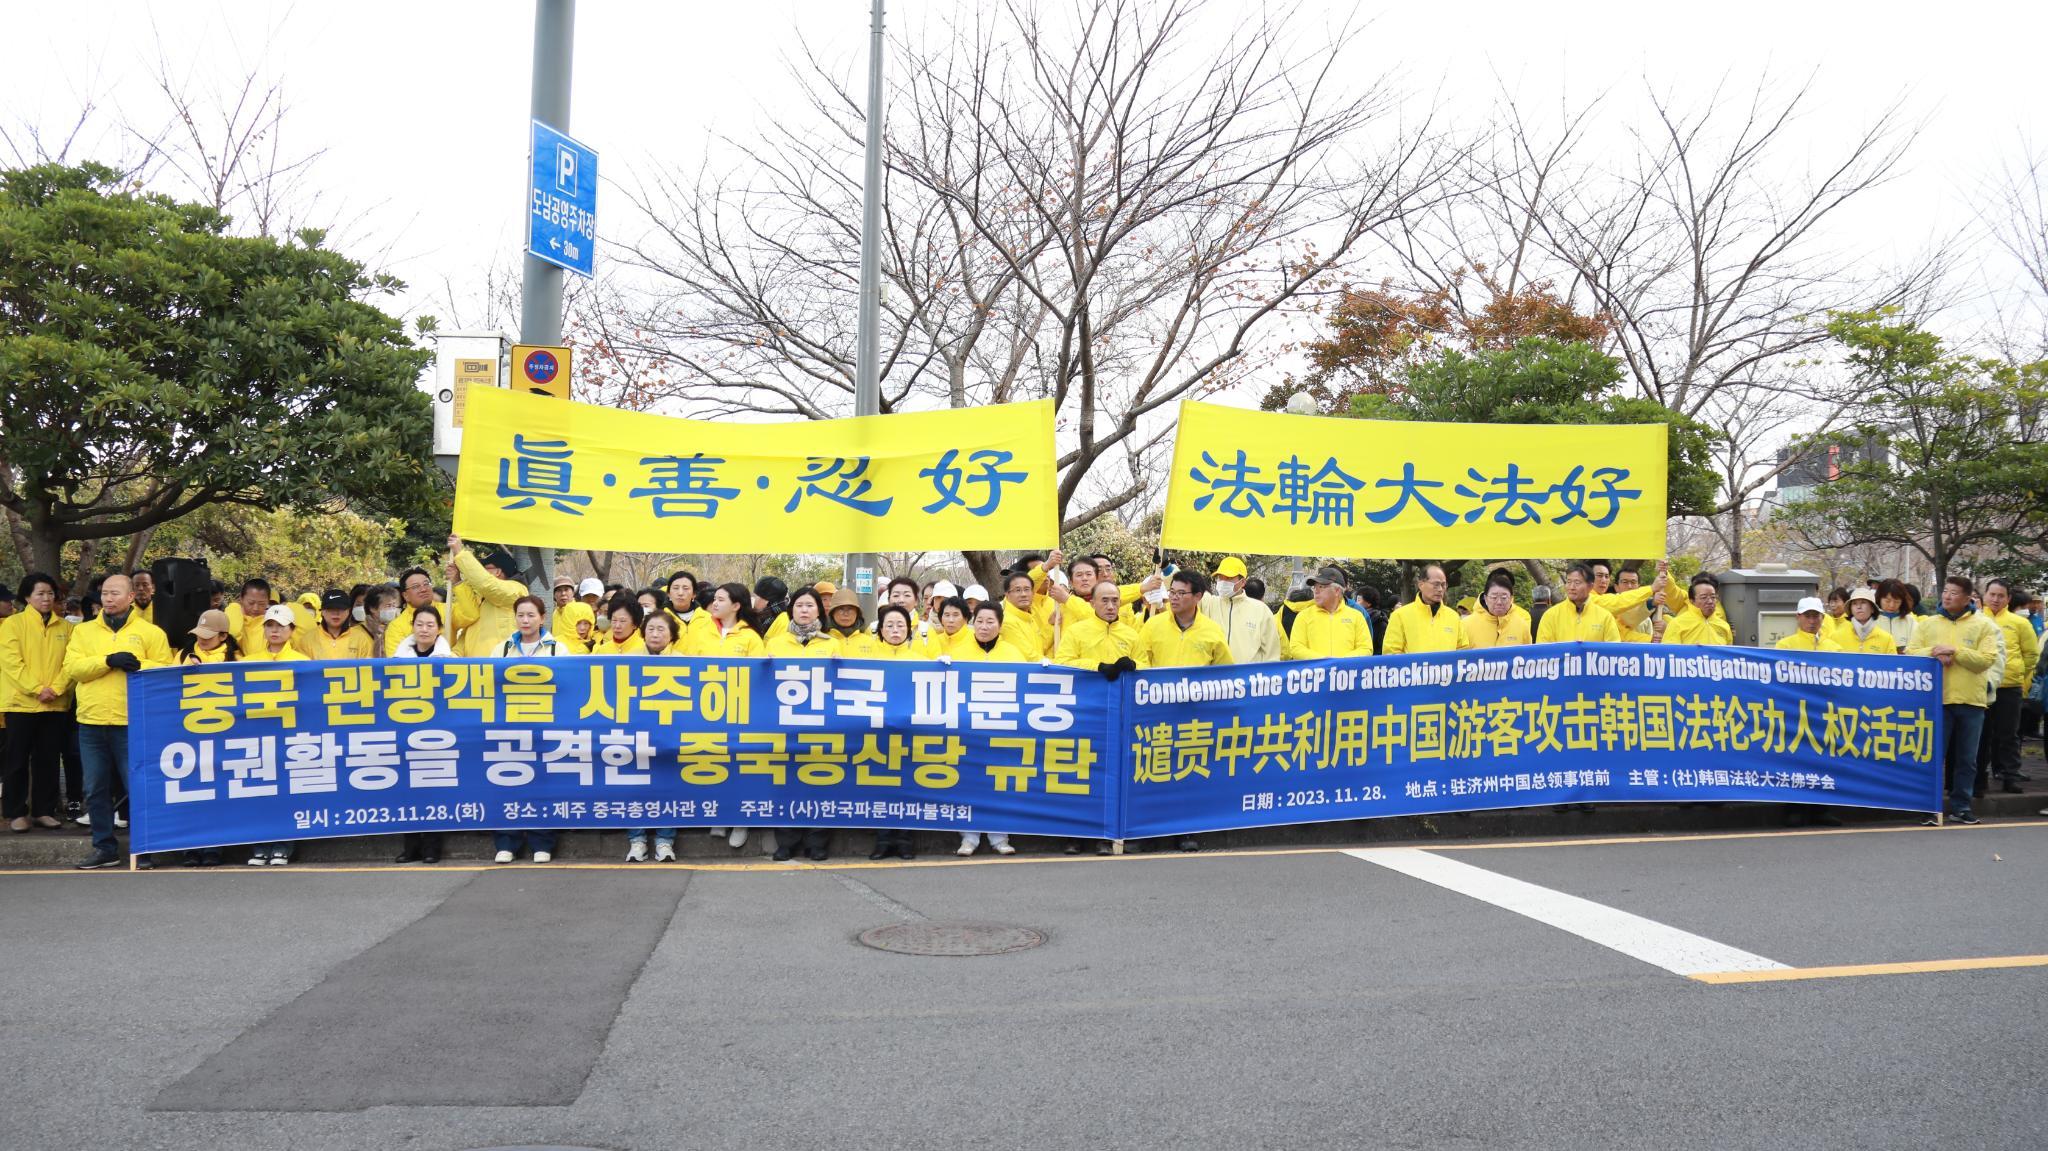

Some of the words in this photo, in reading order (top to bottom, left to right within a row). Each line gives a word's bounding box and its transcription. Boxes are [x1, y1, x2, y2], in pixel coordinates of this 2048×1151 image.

[559, 149, 575, 186] P
[531, 186, 595, 241] 도남공영주차장
[563, 240, 580, 261] 30m
[1190, 449, 1642, 528] 法輪大法好
[179, 669, 299, 734] 중국
[322, 664, 557, 726] 관광객을
[578, 664, 750, 725] 사주해
[775, 665, 887, 728] 한국
[911, 671, 1076, 731] 파룬궁
[1135, 678, 1245, 705] Condemns
[1249, 673, 1282, 696] the
[1287, 668, 1325, 694] CCP
[1329, 667, 1357, 691] for
[1360, 661, 1452, 690] attacking
[1456, 659, 1508, 682] Falun
[1512, 656, 1559, 680] Gong
[1563, 652, 1581, 677] in
[1587, 652, 1639, 676] Korea
[1644, 654, 1665, 679] by
[1669, 654, 1771, 684] instigating
[1775, 661, 1853, 687] Chinese
[1857, 668, 1932, 691] tourists
[1131, 692, 1933, 783] 谴责中共利用中国游客攻击韩国法轮功人权活动
[160, 730, 459, 803] 인권활동을
[483, 729, 656, 786] 공격한
[677, 733, 967, 789] 중국공산당
[985, 737, 1097, 795] 규탄
[1243, 793, 1273, 811] 日期
[1287, 791, 1329, 806] 2023.
[1335, 788, 1357, 802] 11.
[1363, 786, 1385, 800] 28.
[1406, 781, 1437, 797] 地点
[1451, 770, 1609, 795] 驻济州中国总领事馆前
[1629, 770, 1658, 785] 主管
[1673, 770, 1834, 789] (社)韩国法轮大法佛学会
[294, 809, 327, 829] 일시
[344, 801, 485, 825] 2023.11.28.(화)
[504, 802, 537, 819] 장소
[553, 802, 586, 818] 제주
[593, 801, 695, 818] 중국총영사관
[702, 801, 718, 816] 앞
[741, 801, 773, 816] 주관
[790, 801, 971, 821] (사)한국파룬따파불학회
